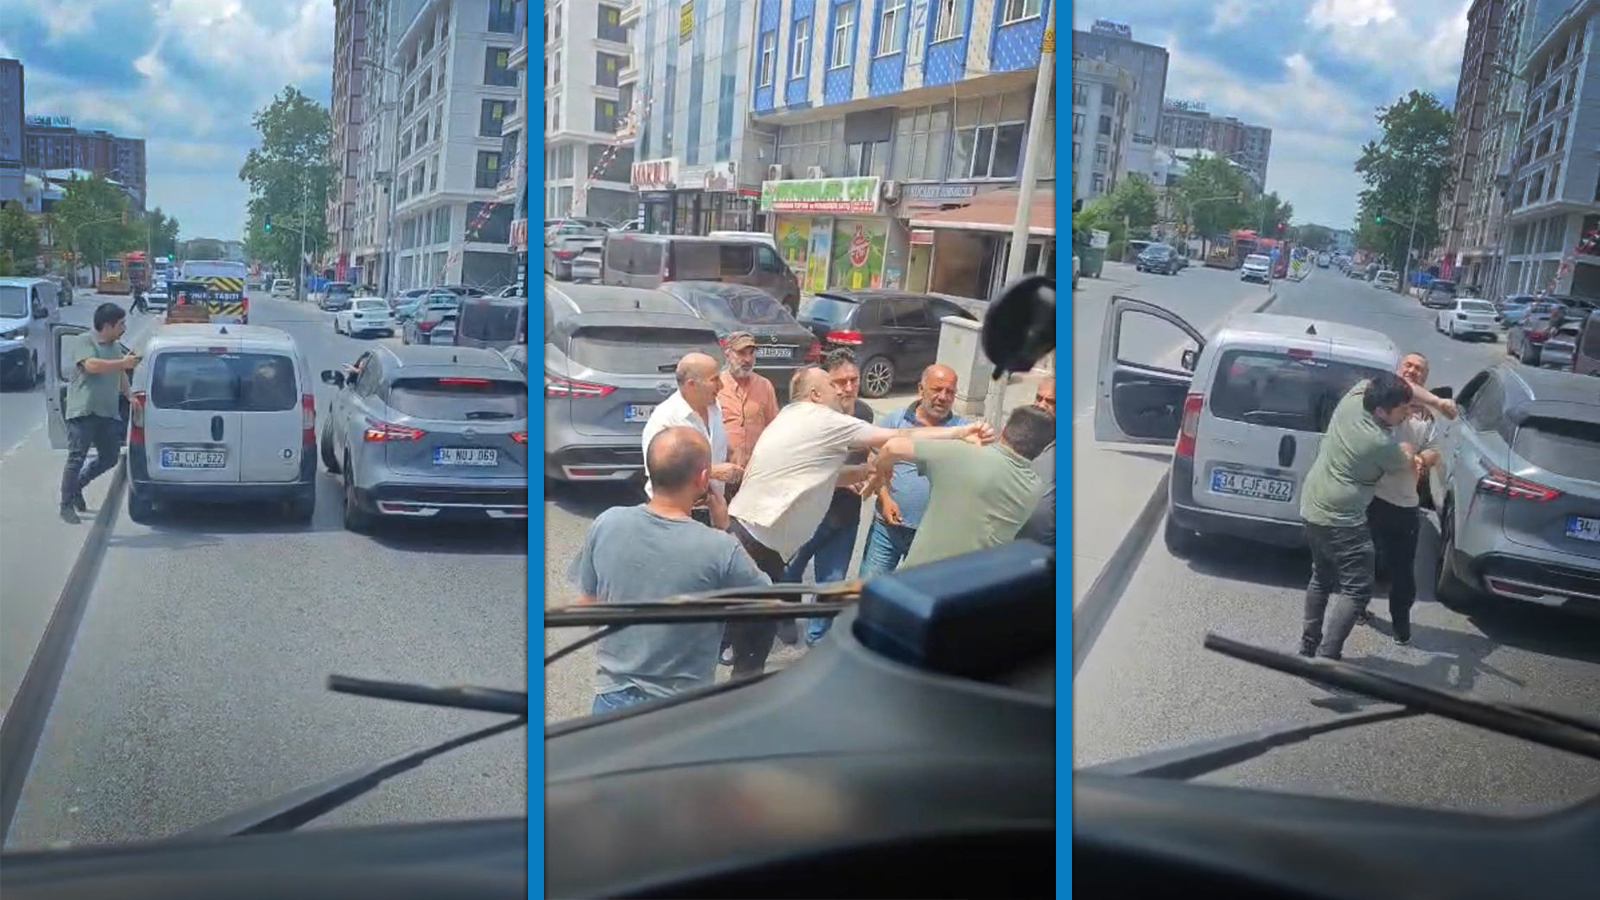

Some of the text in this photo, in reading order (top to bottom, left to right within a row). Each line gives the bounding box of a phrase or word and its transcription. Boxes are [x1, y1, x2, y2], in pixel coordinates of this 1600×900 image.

[168, 452, 223, 464] 34 CJF 622
[441, 449, 450, 460] 34
[1223, 474, 1235, 487] 34
[1241, 477, 1263, 491] CJF
[1268, 480, 1289, 496] 622
